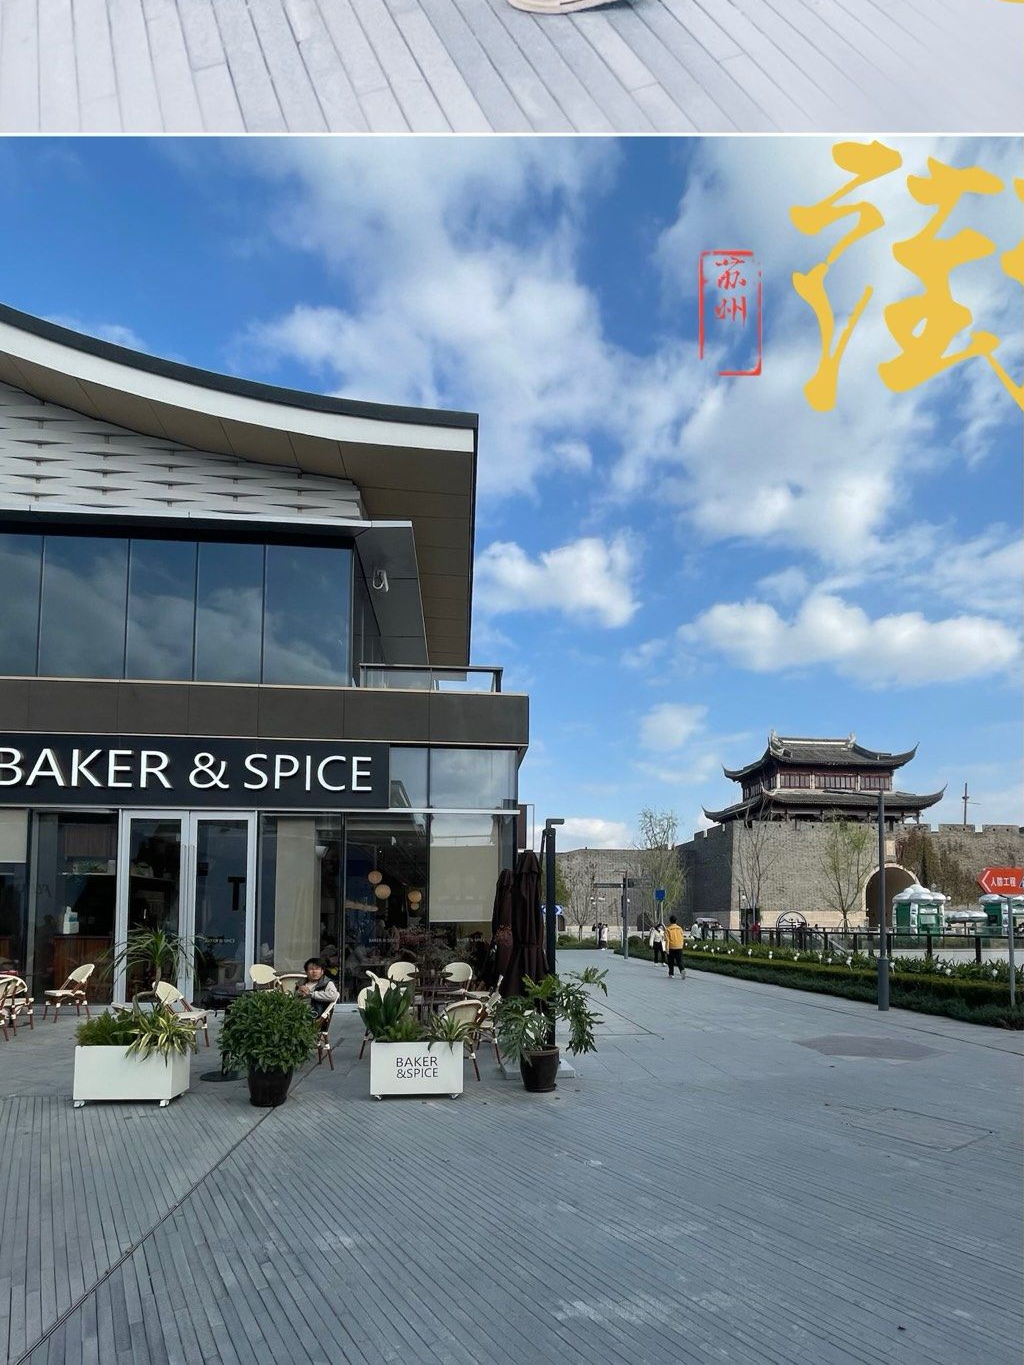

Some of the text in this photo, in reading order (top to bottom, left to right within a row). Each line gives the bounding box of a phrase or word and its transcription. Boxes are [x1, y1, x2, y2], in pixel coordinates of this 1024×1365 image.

[0, 747, 373, 792] BAKER & SPICE
[990, 876, 1017, 888] 人防工程
[396, 1056, 438, 1067] BAKER
[396, 1068, 439, 1079] &SPICE
